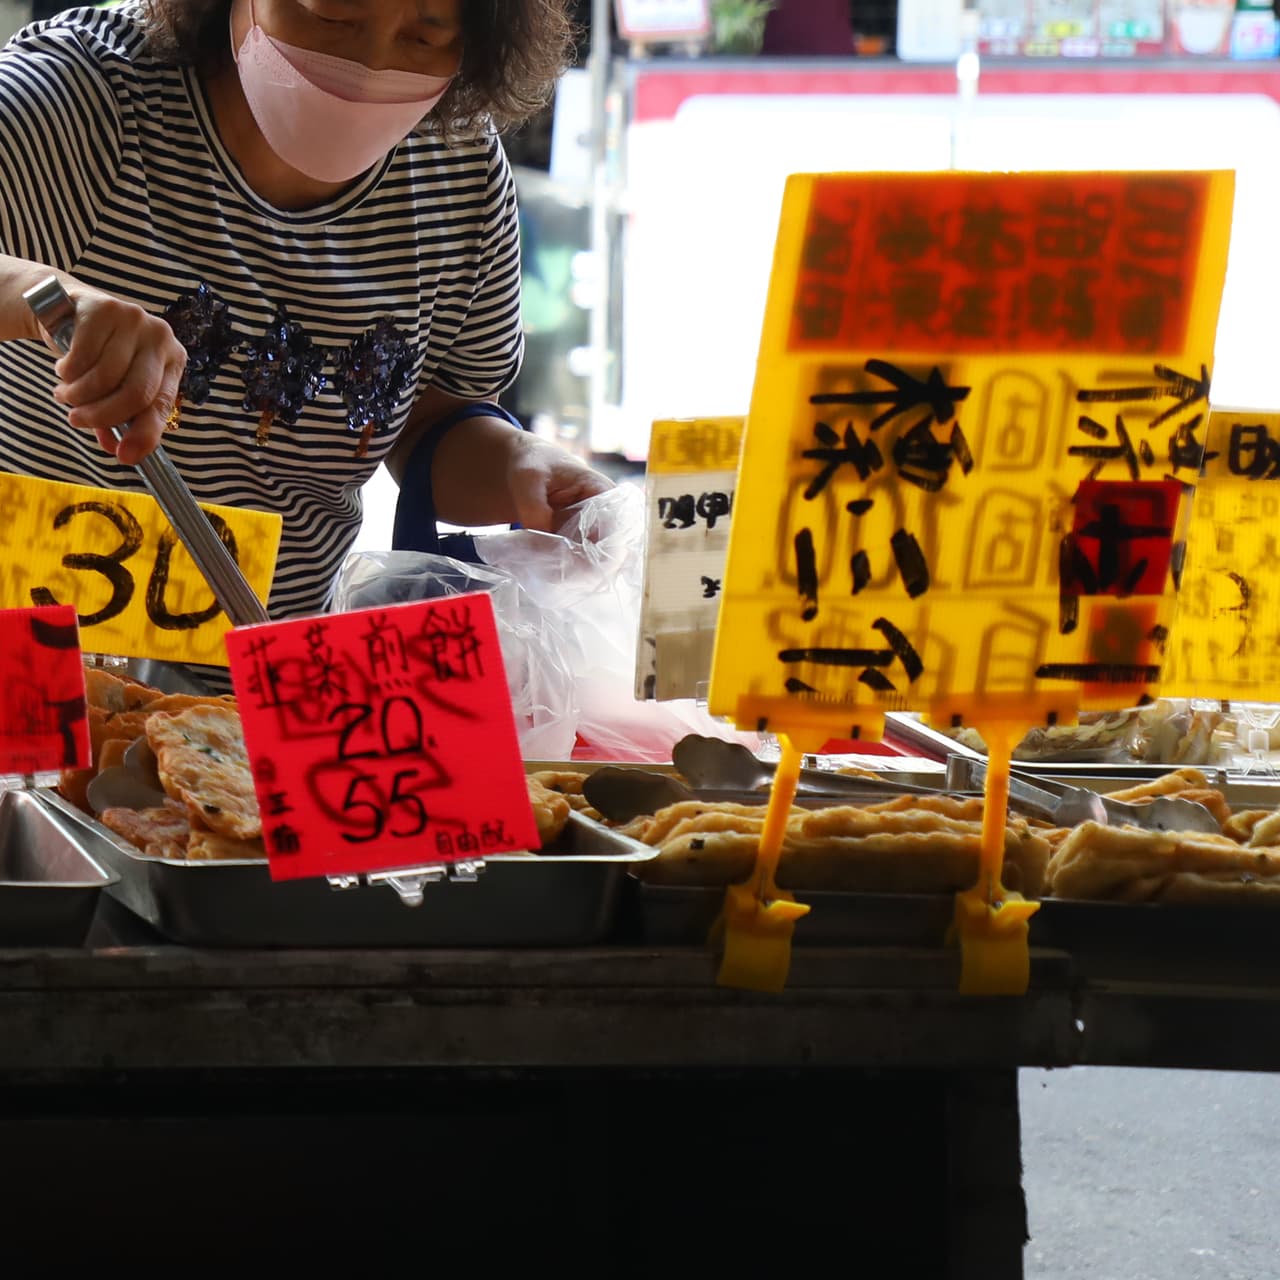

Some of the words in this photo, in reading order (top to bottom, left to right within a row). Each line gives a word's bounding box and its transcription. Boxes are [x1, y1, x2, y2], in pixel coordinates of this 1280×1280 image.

[30, 500, 240, 630] 30
[328, 696, 425, 761] 20
[341, 770, 427, 843] 55
